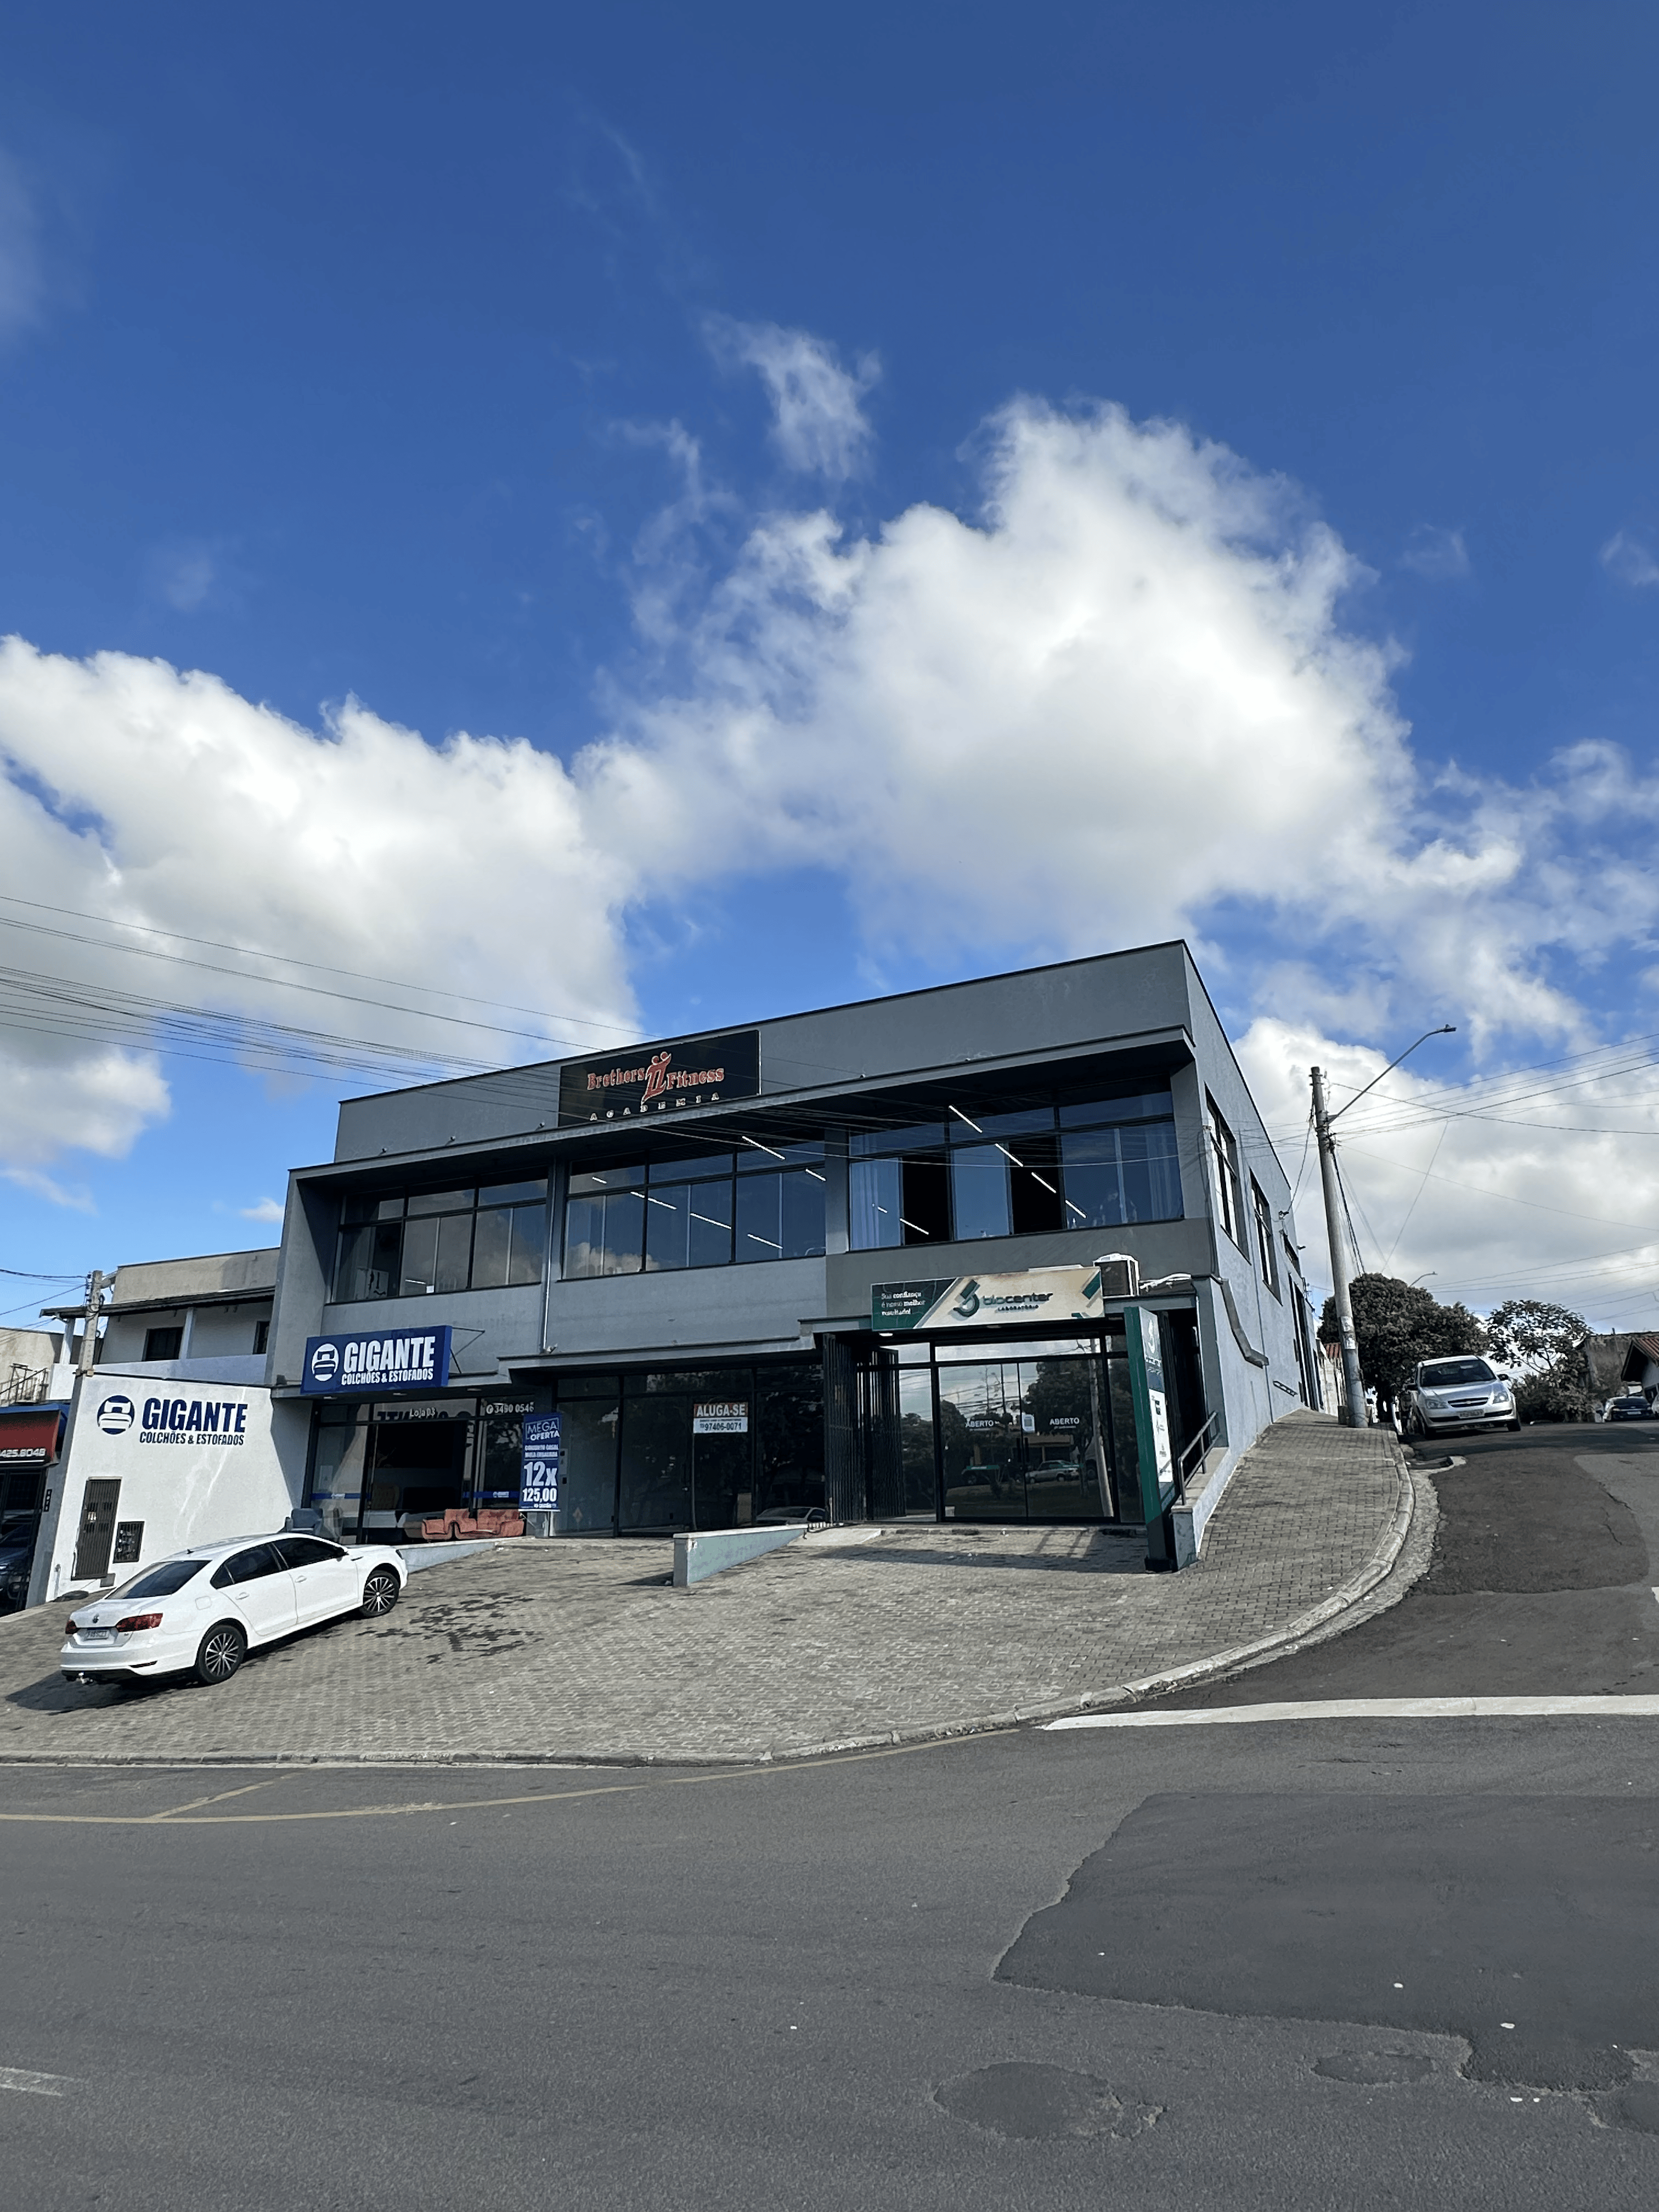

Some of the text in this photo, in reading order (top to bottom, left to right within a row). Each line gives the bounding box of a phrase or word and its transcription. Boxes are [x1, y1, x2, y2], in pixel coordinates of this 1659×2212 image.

[587, 1068, 724, 1091] Brothers Fitness
[589, 1092, 720, 1121] ACADEMIA
[983, 1293, 1053, 1306] biocenter
[343, 1336, 436, 1373] GIGANTE
[341, 1368, 434, 1385] COLCHÕES & ESTOFADOS
[142, 1397, 248, 1432] GIGANTE
[409, 1408, 426, 1419] Loja
[697, 1404, 746, 1417] ALUGA-SE
[527, 1421, 557, 1434] MEGA
[1049, 1417, 1080, 1425] ABERTO
[139, 1431, 244, 1446] COLCHÕES & ESTOFADOS
[530, 1430, 560, 1441] OFERTA
[0, 1448, 46, 1458] 425.8048
[523, 1487, 557, 1503] 125,00
